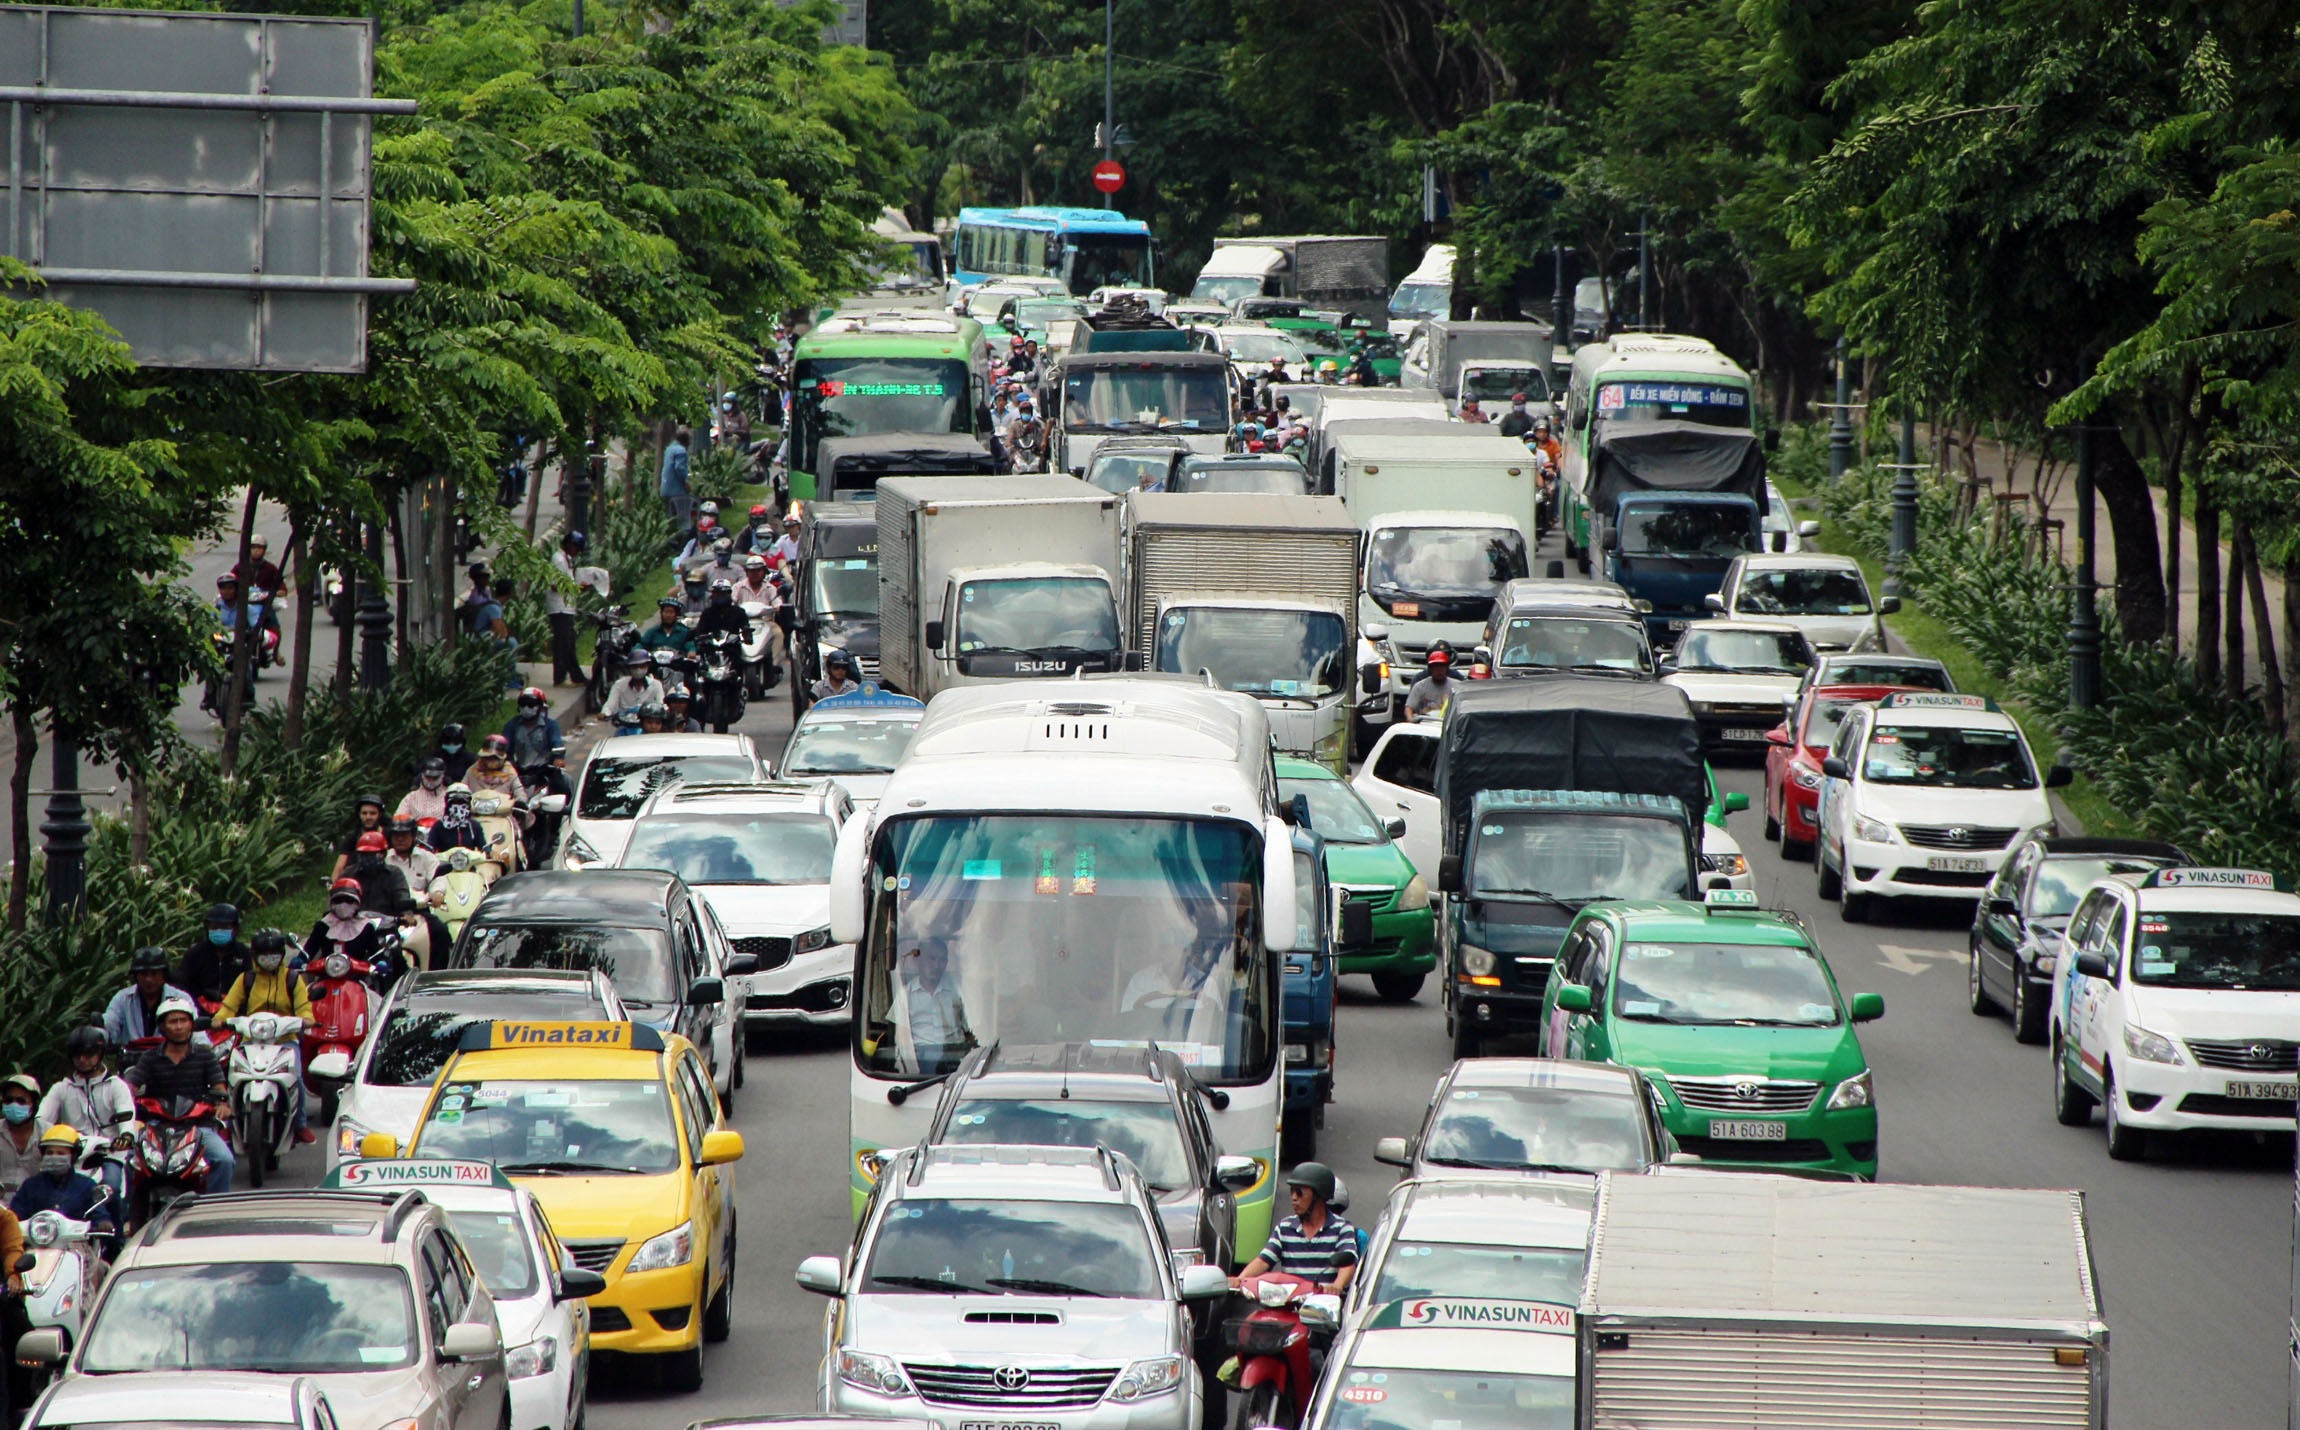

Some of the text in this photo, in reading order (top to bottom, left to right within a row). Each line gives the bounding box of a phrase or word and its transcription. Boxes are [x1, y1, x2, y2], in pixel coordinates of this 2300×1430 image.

[1602, 386, 1622, 407] 64
[1647, 388, 1658, 400] XE
[1015, 661, 1066, 672] ISUZU
[503, 1025, 622, 1043] Vinataxi
[478, 1090, 507, 1098] 5044
[1344, 1390, 1383, 1401] 4510
